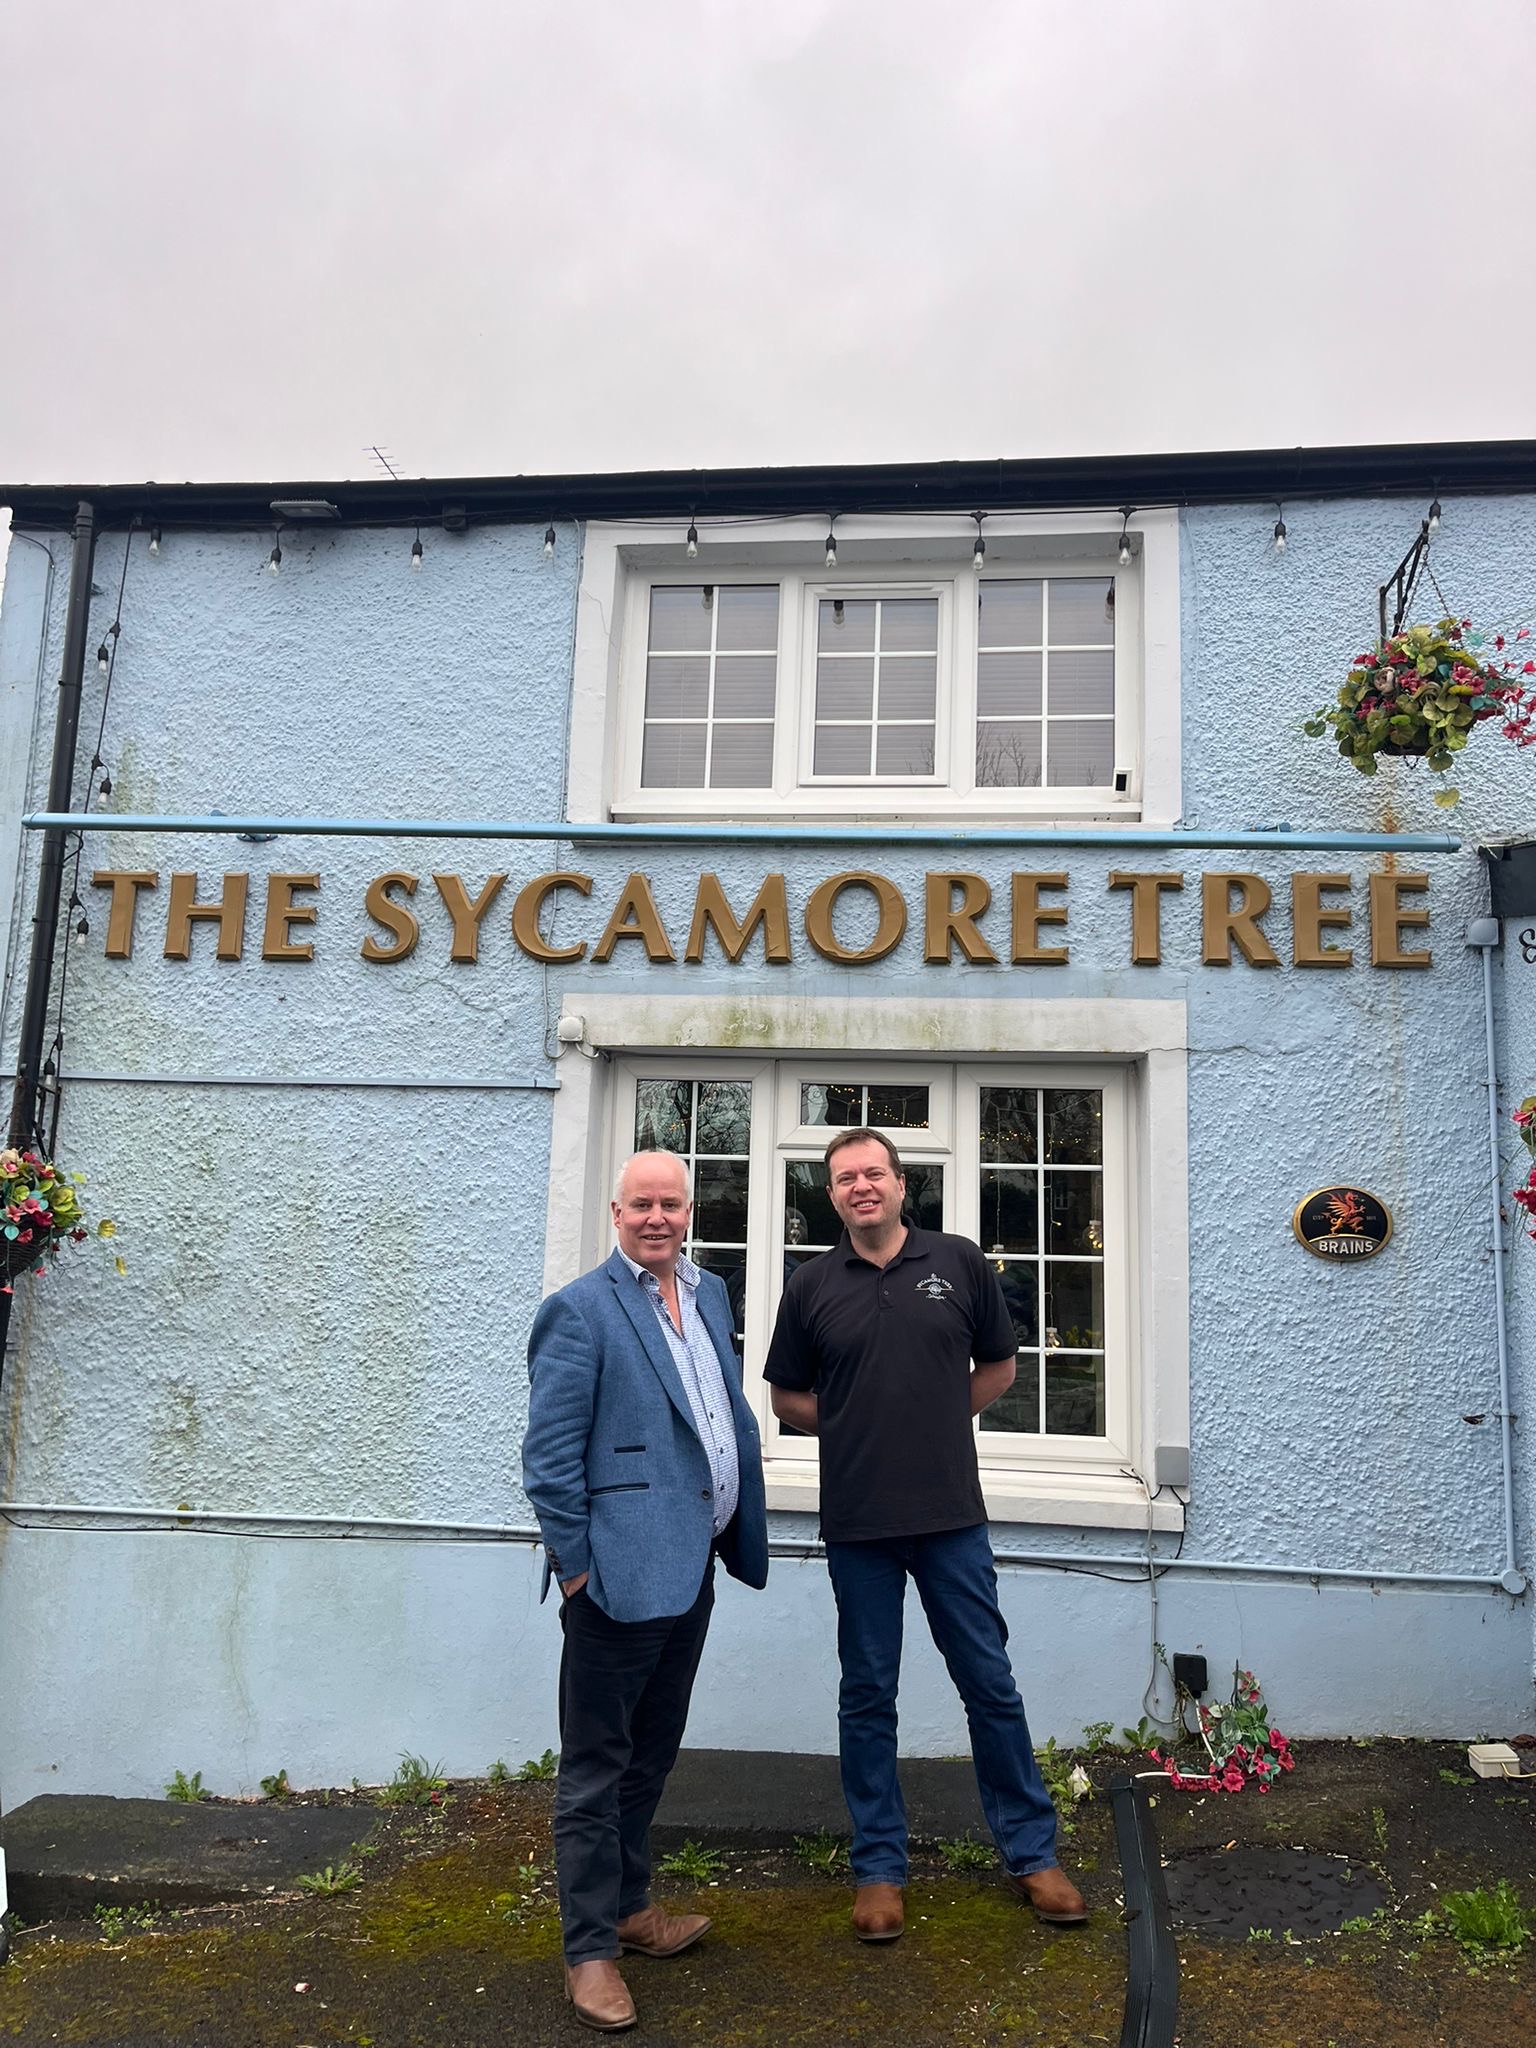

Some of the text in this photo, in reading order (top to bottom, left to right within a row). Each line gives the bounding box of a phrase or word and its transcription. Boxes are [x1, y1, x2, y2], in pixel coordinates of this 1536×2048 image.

[92, 870, 1433, 968] THE SYCAMORE TREE
[1319, 1240, 1373, 1254] BRAINS
